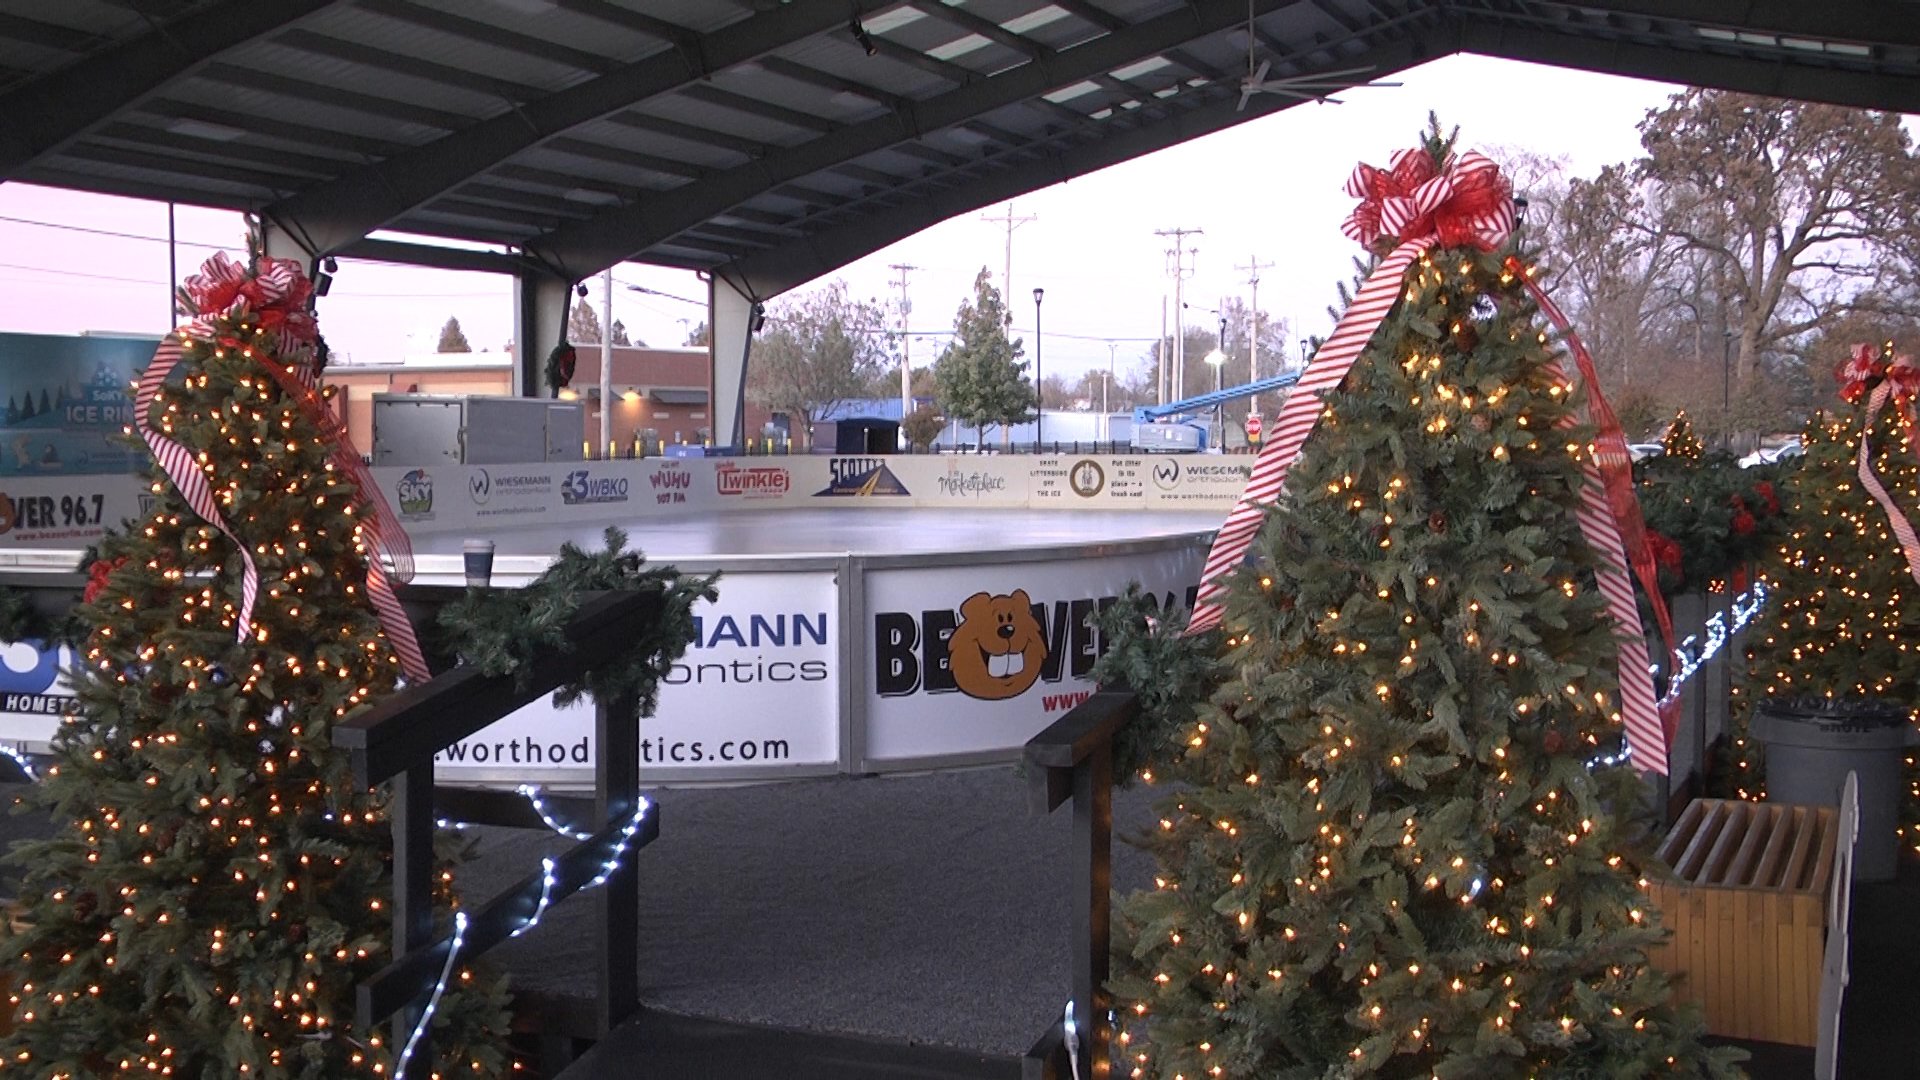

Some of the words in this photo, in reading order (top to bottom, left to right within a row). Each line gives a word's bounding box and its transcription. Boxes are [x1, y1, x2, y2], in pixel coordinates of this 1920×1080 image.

[66, 406, 98, 424] ICE
[103, 406, 136, 423] RIN
[495, 476, 552, 487] WIESEMANN
[589, 478, 629, 497] WBKO
[649, 470, 691, 489] WUHU
[61, 494, 104, 526] 96.7
[661, 656, 828, 685] ontics
